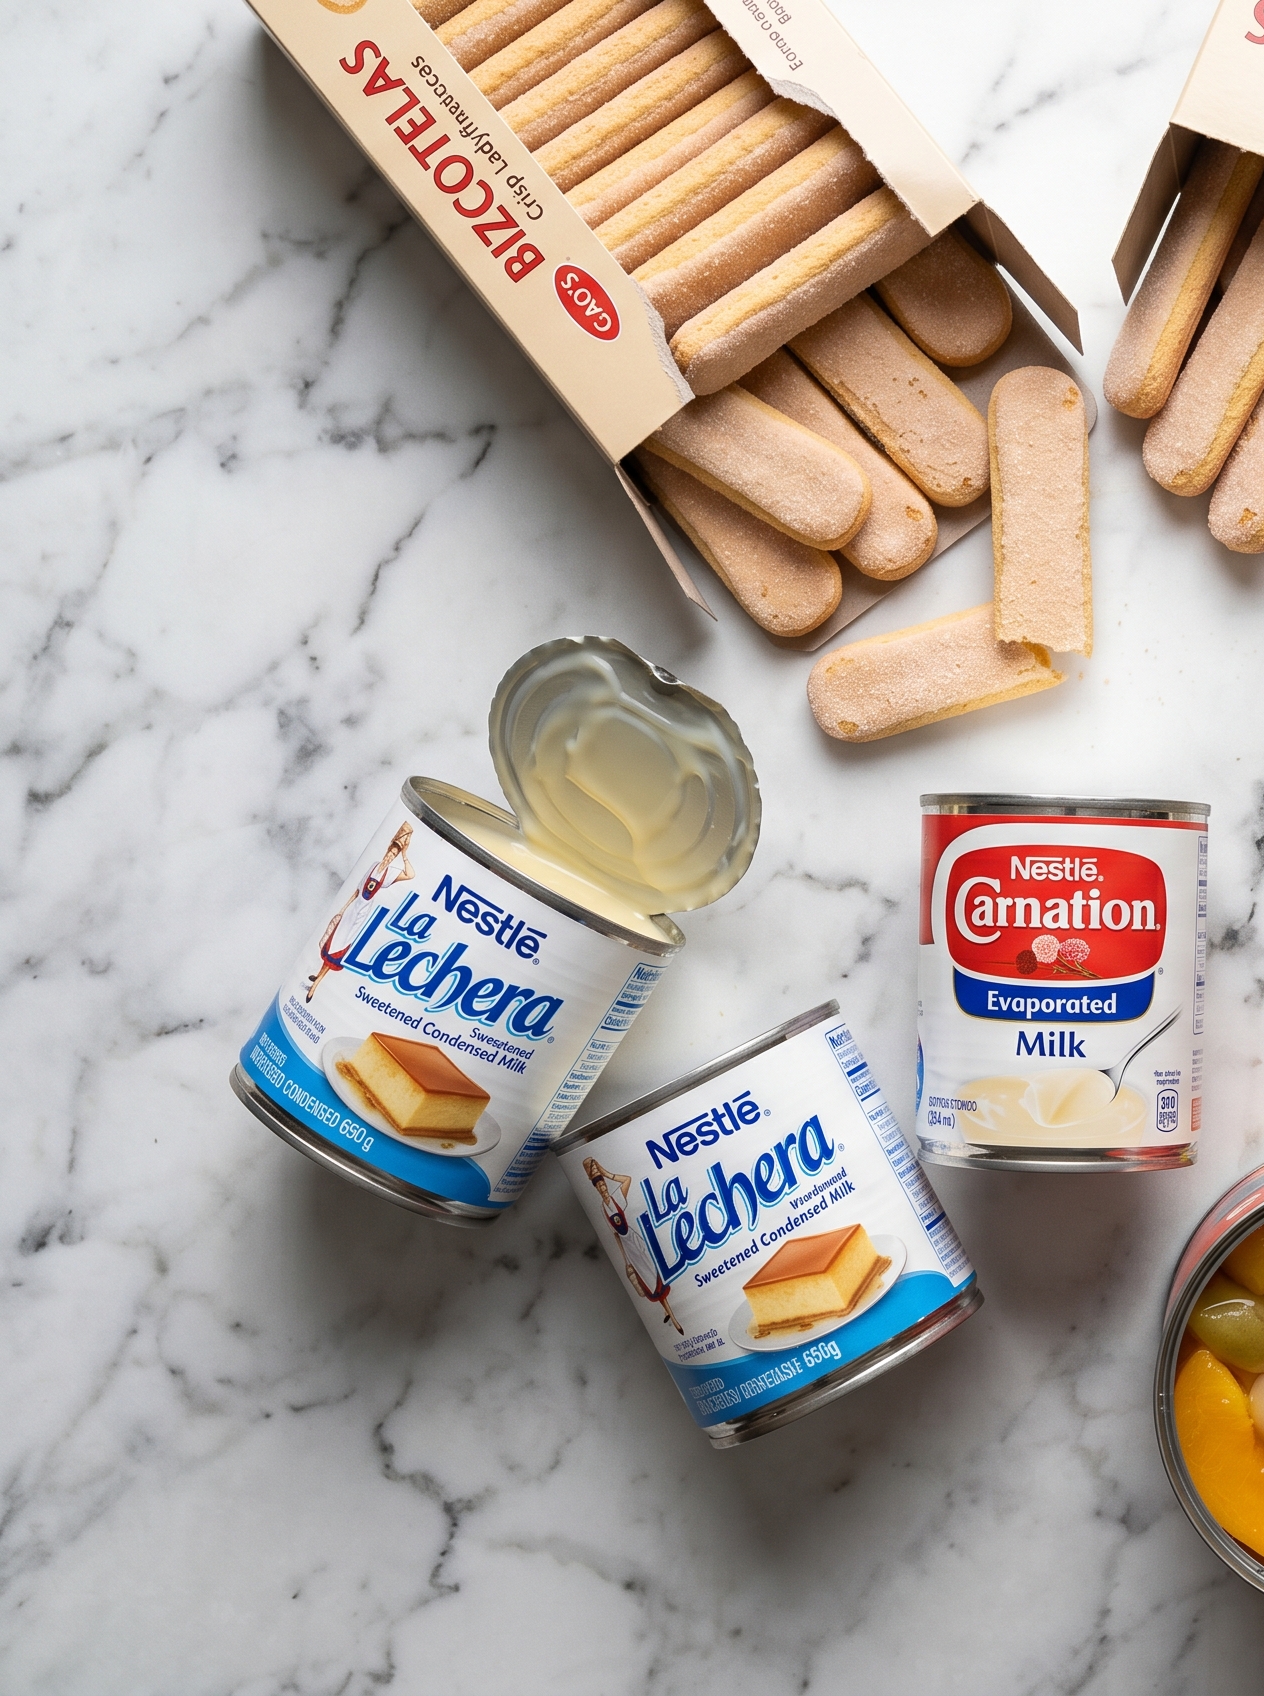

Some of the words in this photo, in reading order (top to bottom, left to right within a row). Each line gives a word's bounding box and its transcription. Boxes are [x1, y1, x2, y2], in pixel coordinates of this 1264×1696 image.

[339, 40, 546, 284] BIZCOTELAS
[506, 175, 544, 221] Crisp
[560, 272, 612, 332] GAO'S
[384, 891, 437, 943] La
[955, 876, 1156, 943] Carnation
[340, 906, 565, 1043] Lechera
[988, 990, 1117, 1018] Evaporated
[355, 985, 422, 1030] Sweetened
[422, 1021, 499, 1066] Condensed
[498, 1054, 527, 1075] Milk
[1016, 1031, 1087, 1058] Milk
[636, 1113, 836, 1281] Lechera
[640, 1174, 689, 1225] La
[694, 1239, 760, 1288] Sweetened
[760, 1199, 828, 1247] Condensed
